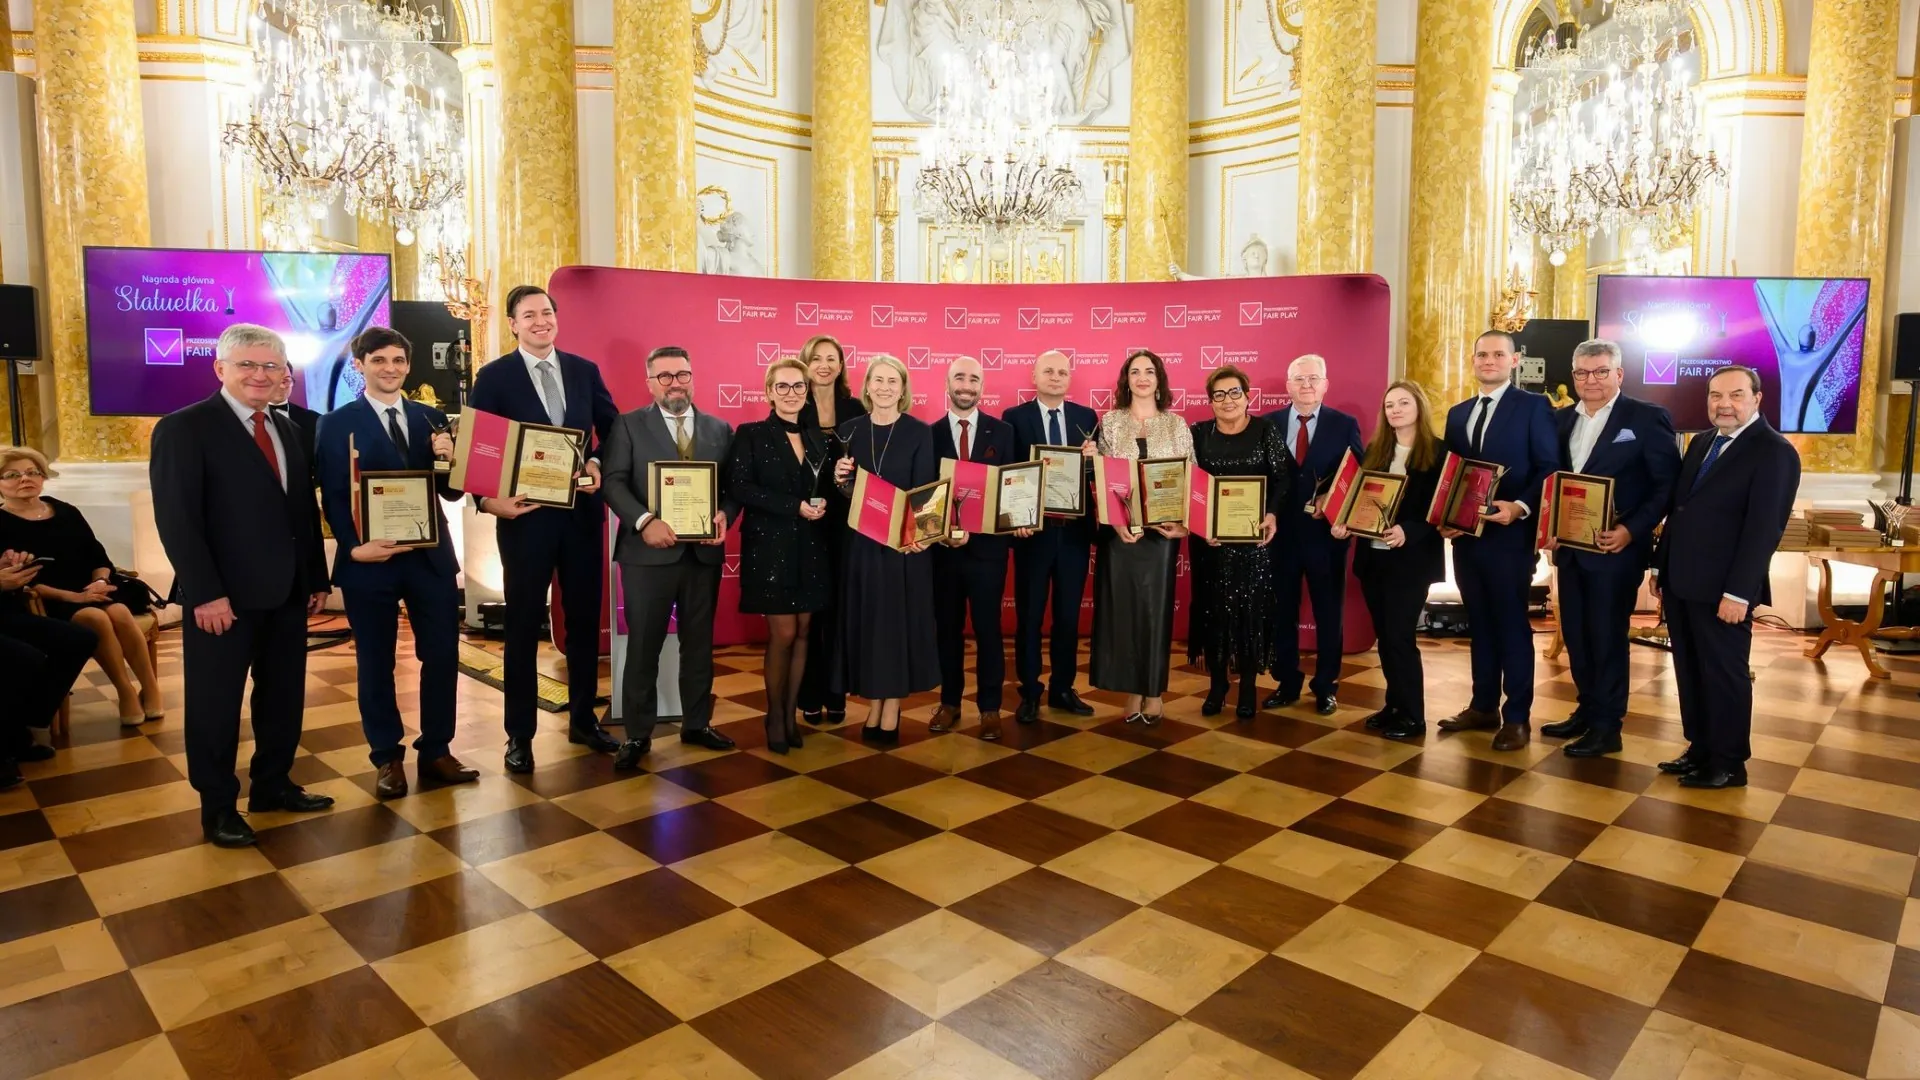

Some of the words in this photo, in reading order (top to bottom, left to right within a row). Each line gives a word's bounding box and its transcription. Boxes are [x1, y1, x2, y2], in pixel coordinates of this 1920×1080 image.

[142, 275, 179, 285] Nagroda
[182, 276, 215, 286] główna
[115, 285, 219, 312] Statuetka
[742, 310, 758, 318] FAIR
[759, 311, 778, 319] PLAY
[1203, 314, 1222, 322] PLAY
[1280, 311, 1298, 319] PLAY
[910, 316, 928, 324] PLAY
[1056, 317, 1074, 325] PLAY
[186, 346, 213, 357] FAIR
[1166, 356, 1183, 364] PLAY
[1680, 367, 1702, 376] FAIR
[1705, 368, 1714, 376] PL
[742, 395, 758, 403] FAIR
[1261, 398, 1277, 406] FAIR
[1278, 398, 1292, 406] PLA
